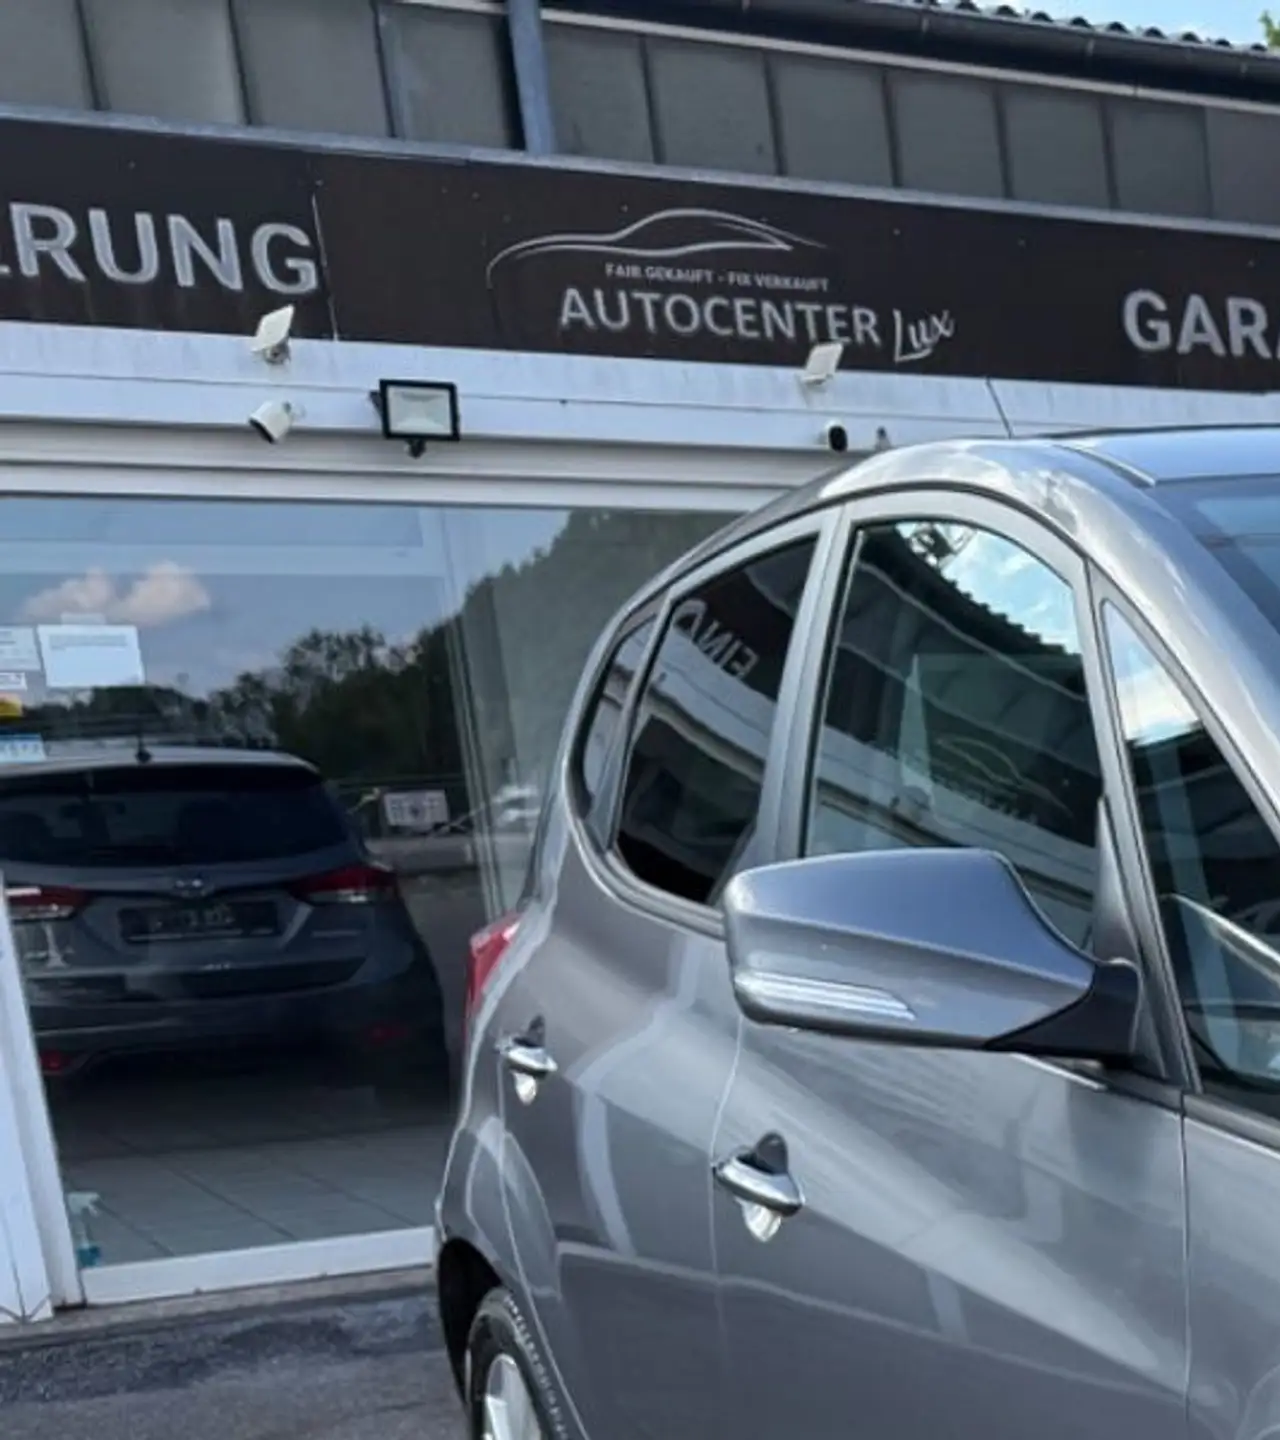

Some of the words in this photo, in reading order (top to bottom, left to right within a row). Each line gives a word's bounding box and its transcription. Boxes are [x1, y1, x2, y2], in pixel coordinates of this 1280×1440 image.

[0, 203, 318, 295] RUNG
[558, 286, 881, 347] AUTOCENTER
[892, 307, 956, 362] Lux
